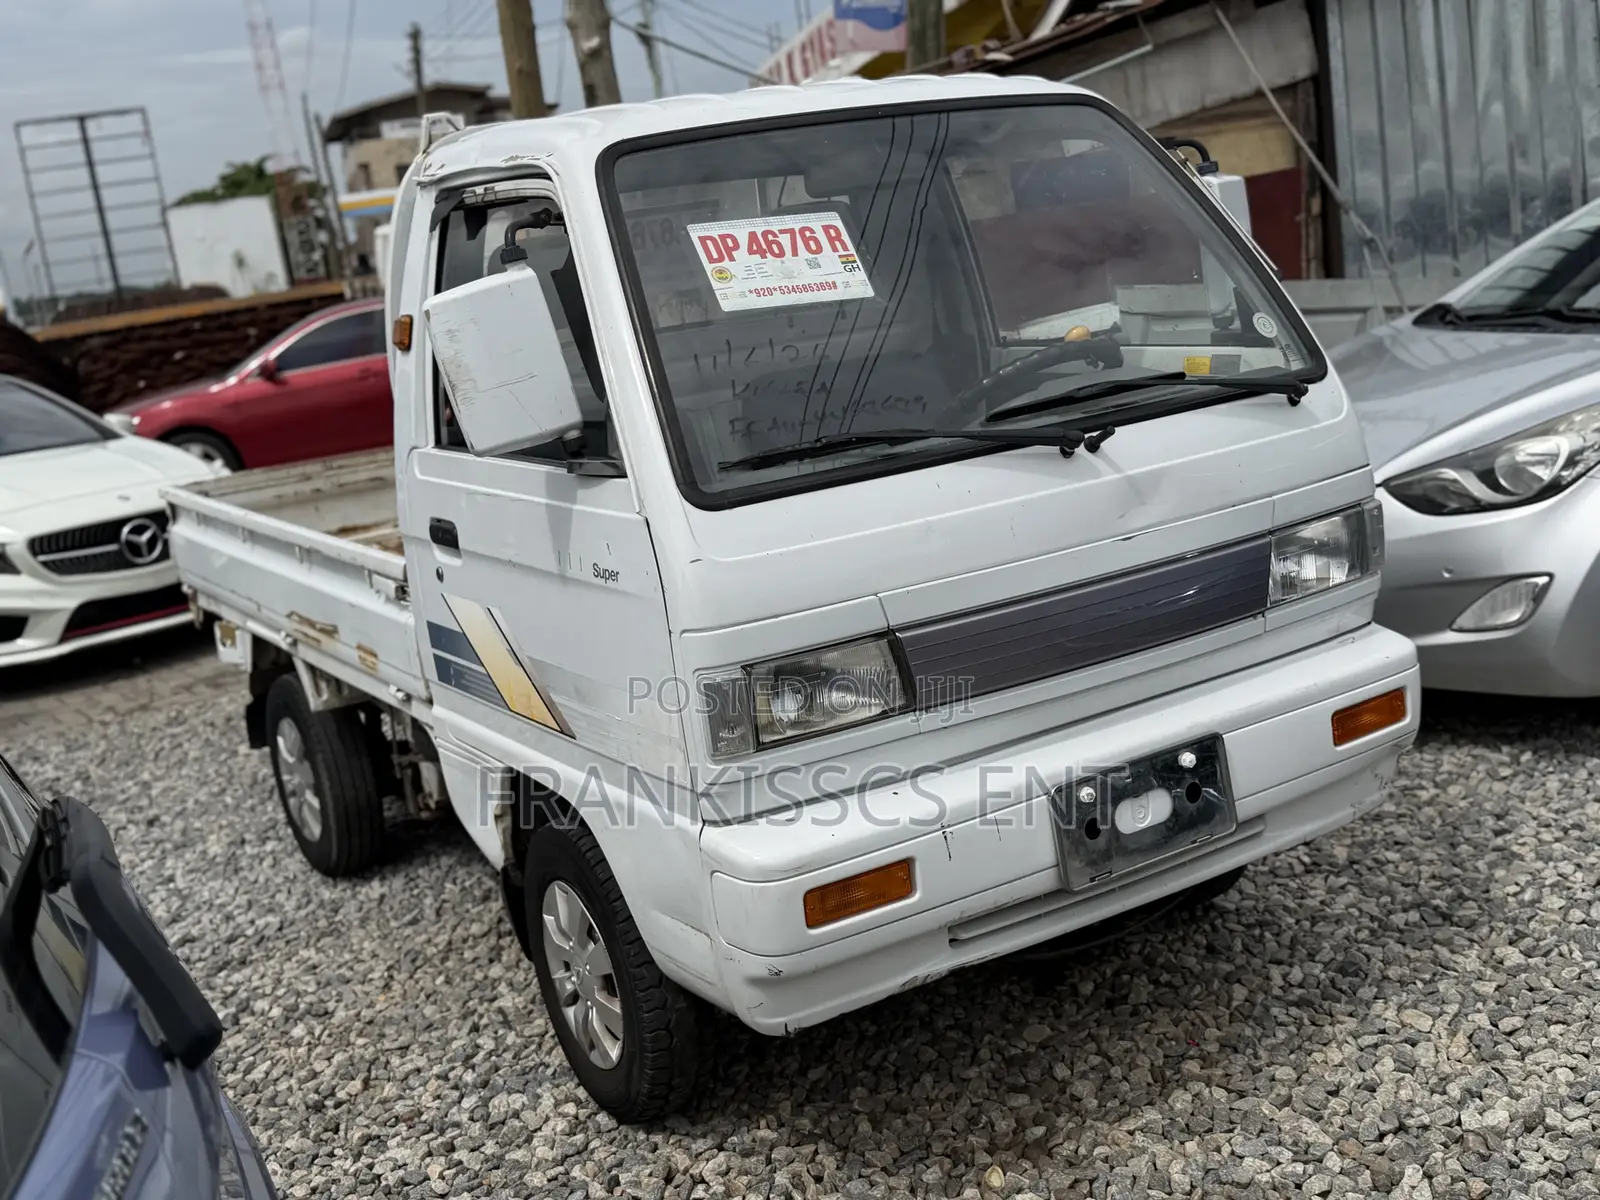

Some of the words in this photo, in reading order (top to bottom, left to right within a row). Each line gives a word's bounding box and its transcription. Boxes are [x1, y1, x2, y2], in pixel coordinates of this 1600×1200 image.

[698, 233, 740, 265] DP
[746, 225, 824, 260] 4676
[821, 223, 851, 253] R
[843, 263, 862, 274] GH
[592, 562, 620, 584] Super
